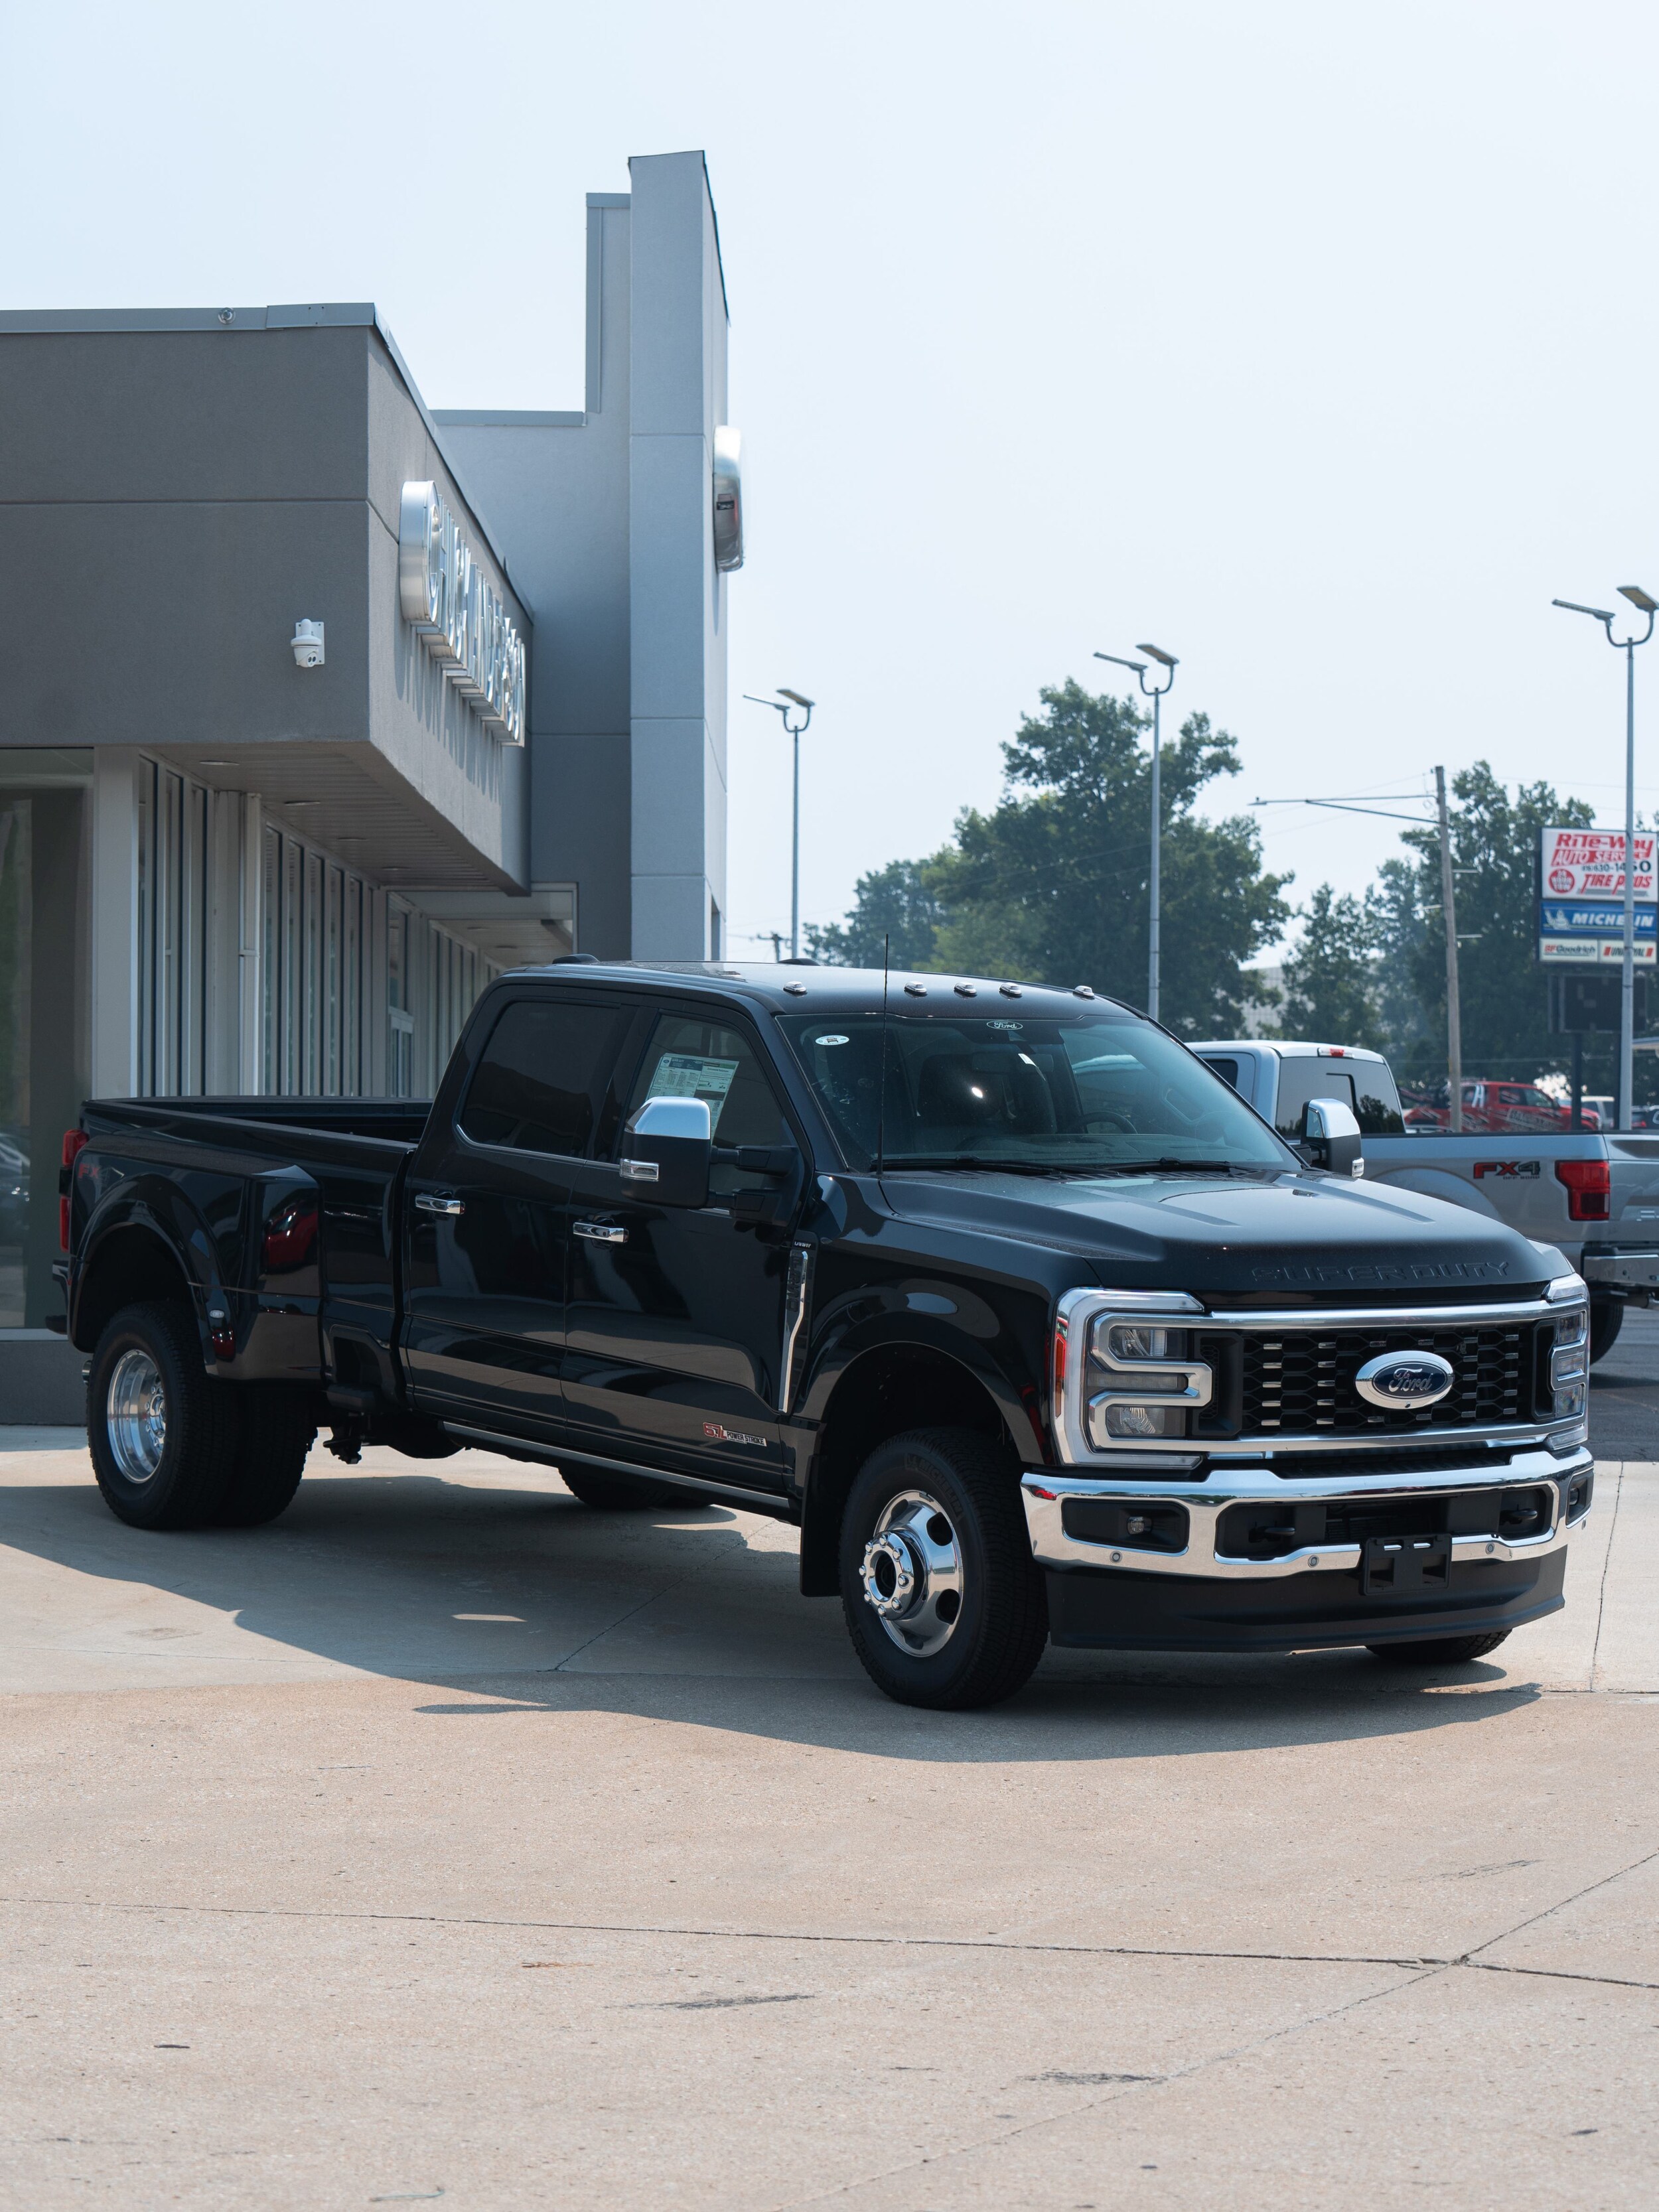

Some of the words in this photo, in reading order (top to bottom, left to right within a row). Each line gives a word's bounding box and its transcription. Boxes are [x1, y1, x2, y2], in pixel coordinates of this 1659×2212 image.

[1553, 850, 1589, 865] AUTO
[1594, 851, 1646, 862] SERVE
[1581, 874, 1613, 894] TIRE
[1612, 874, 1652, 894] POS
[1572, 912, 1654, 928] MICHEIN
[1473, 1161, 1540, 1179] FX4
[1252, 1265, 1408, 1282] SUPER
[1411, 1261, 1509, 1280] DUTY
[1388, 1367, 1433, 1393] Ford
[703, 1422, 727, 1440] 6.7L
[727, 1431, 745, 1441] POWER
[745, 1435, 764, 1445] STROKE
